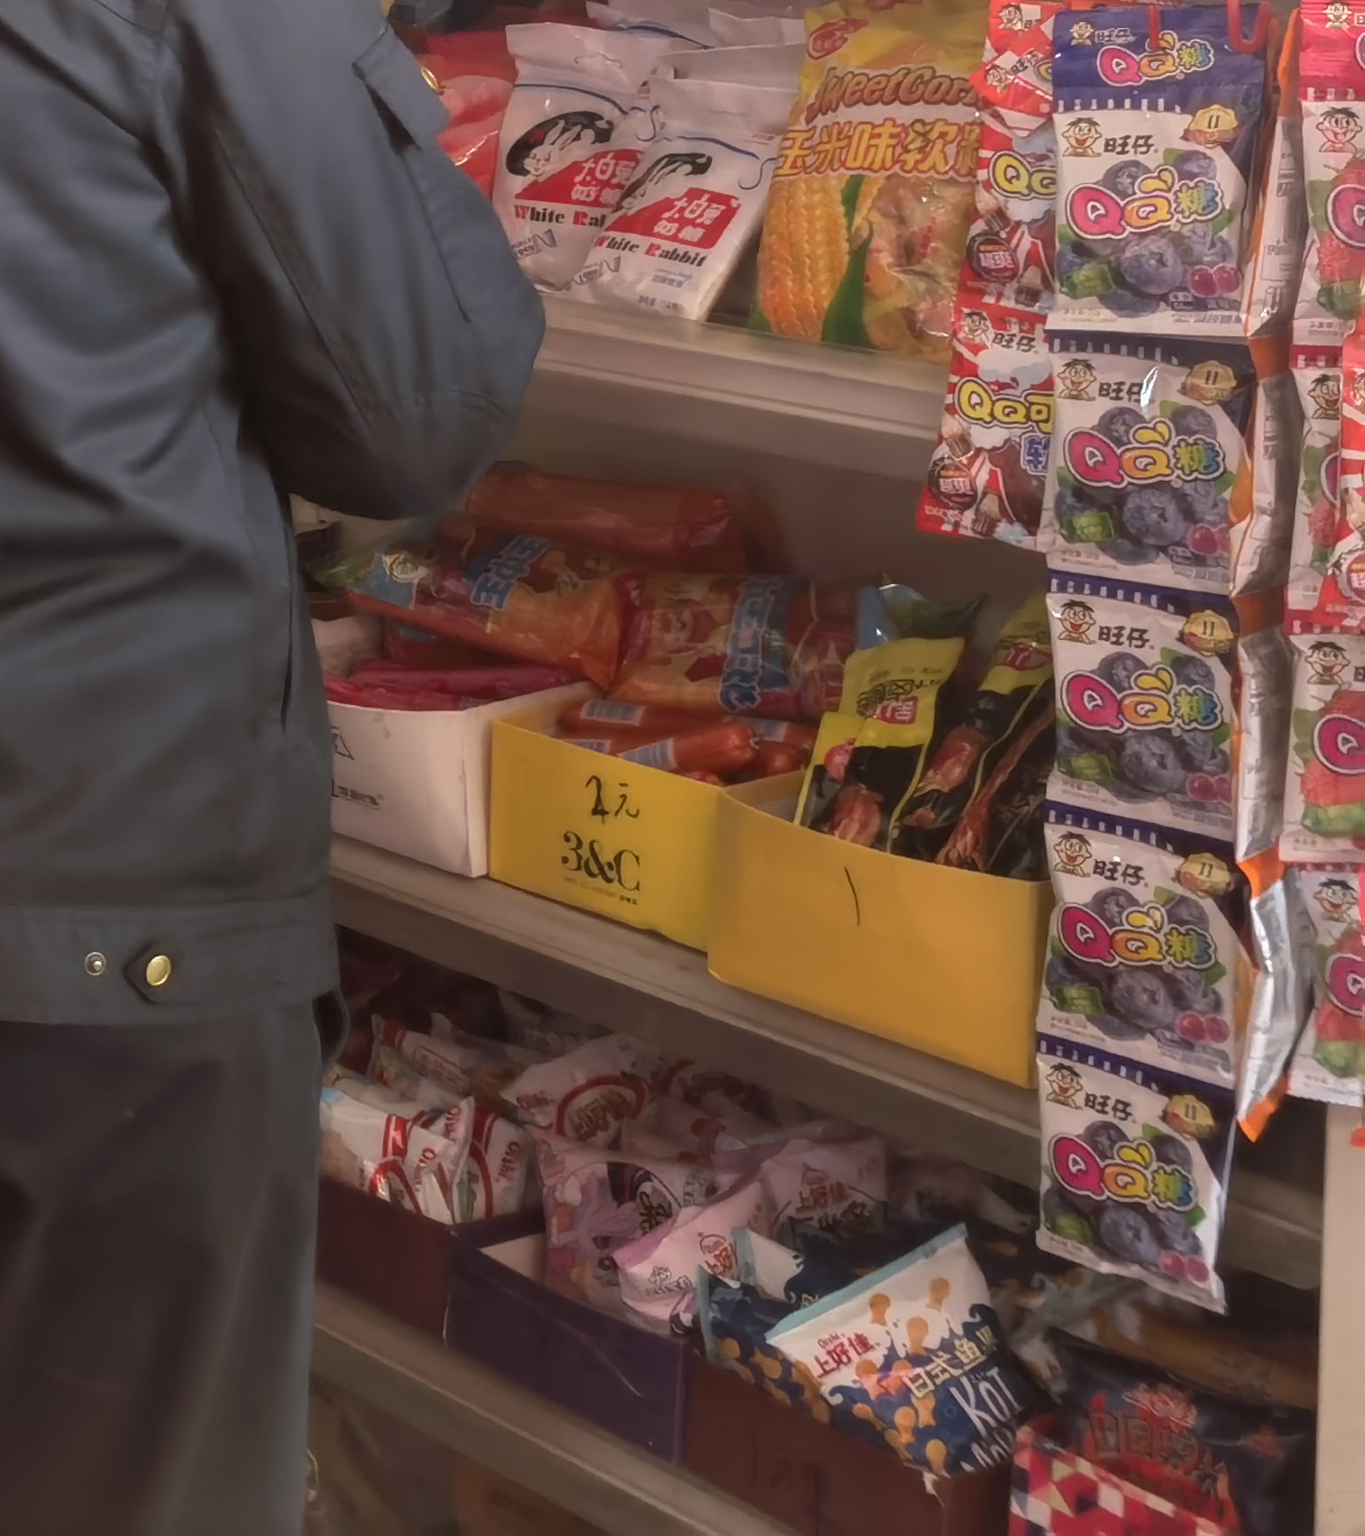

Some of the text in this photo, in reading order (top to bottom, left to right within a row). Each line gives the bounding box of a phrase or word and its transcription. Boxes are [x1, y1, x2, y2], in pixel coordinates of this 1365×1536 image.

[1097, 39, 1215, 87] QQ糖
[1103, 134, 1155, 156] 旺仔
[514, 205, 566, 226] White
[1066, 176, 1224, 240] QQ糖
[595, 234, 707, 269] White Rabbit
[991, 331, 1036, 355] 旺仔
[1098, 381, 1149, 403] 旺仔
[1064, 427, 1227, 489] QQ糖
[1098, 625, 1151, 648] 旺仔
[1060, 669, 1223, 732] QQ糖
[1092, 860, 1146, 885] 旺仔
[1057, 902, 1218, 968] QQ糖
[1083, 1094, 1134, 1121] 旺仔
[1049, 1131, 1198, 1212] QQ糖
